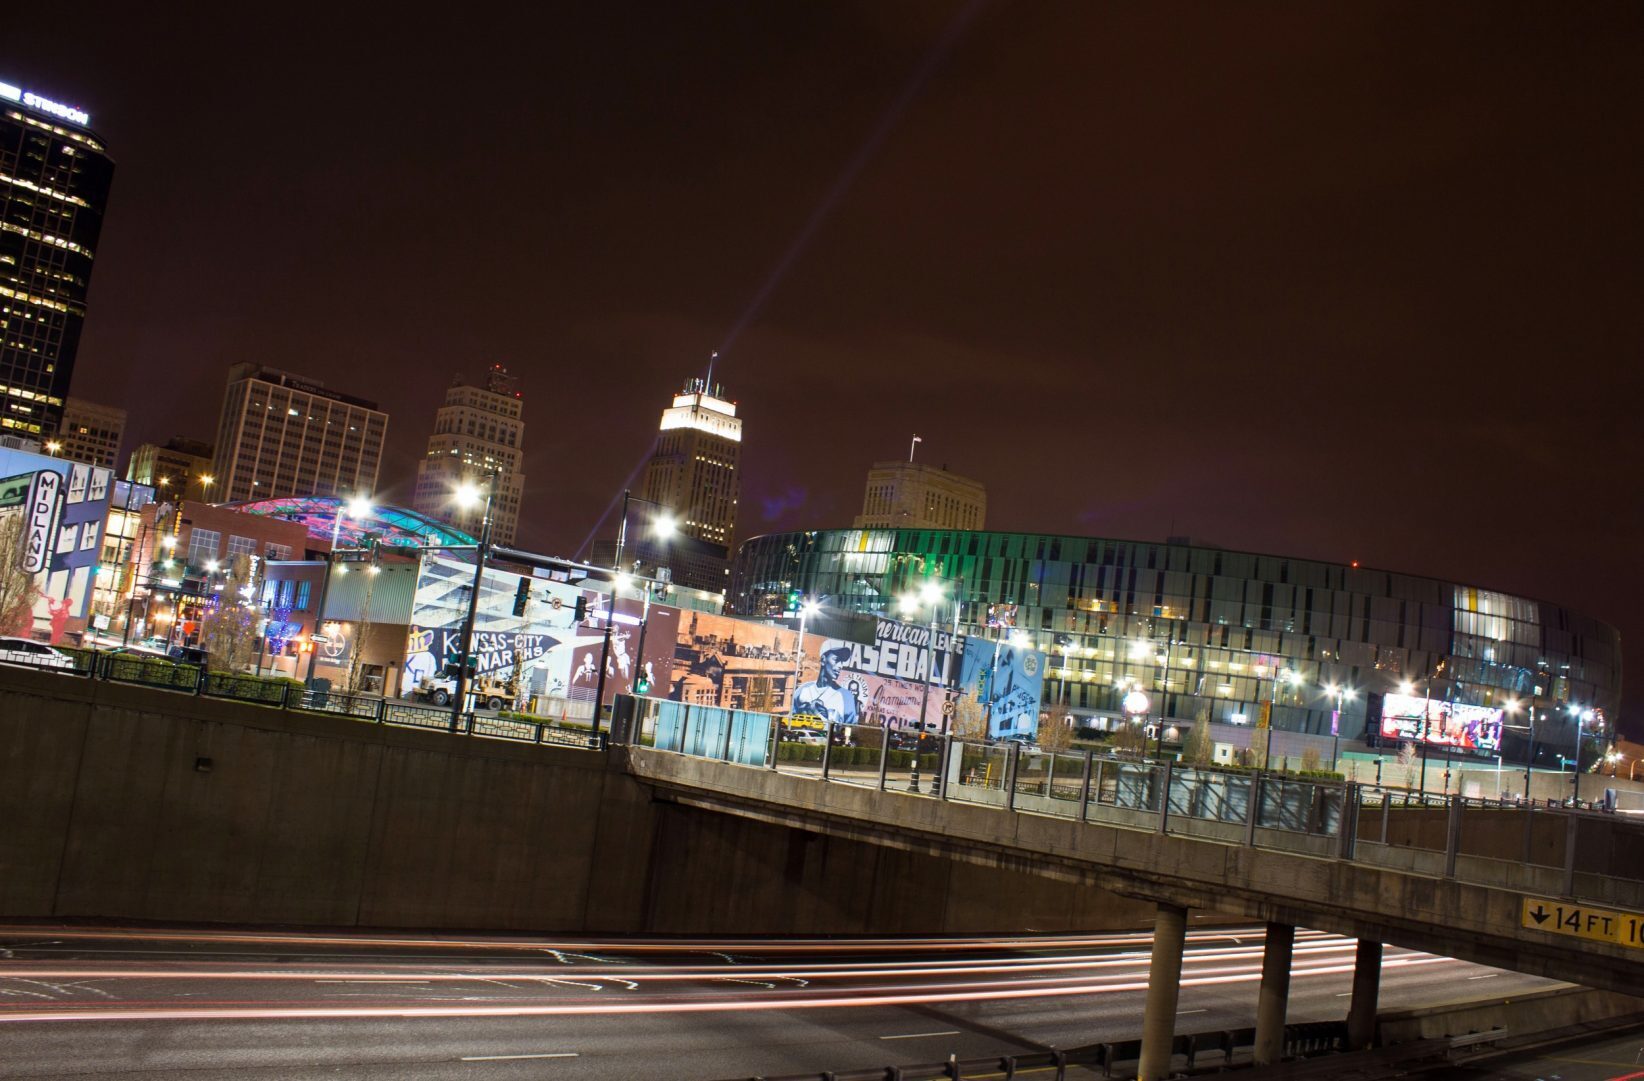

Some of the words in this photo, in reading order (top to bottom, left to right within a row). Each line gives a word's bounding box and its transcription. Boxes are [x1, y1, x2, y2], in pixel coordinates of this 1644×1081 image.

[25, 475, 55, 568] MIDLAND
[442, 631, 543, 655] KNSAS-CITY
[841, 640, 956, 687] ASEBALL
[1556, 907, 1581, 933] 14
[1587, 915, 1613, 936] FT.
